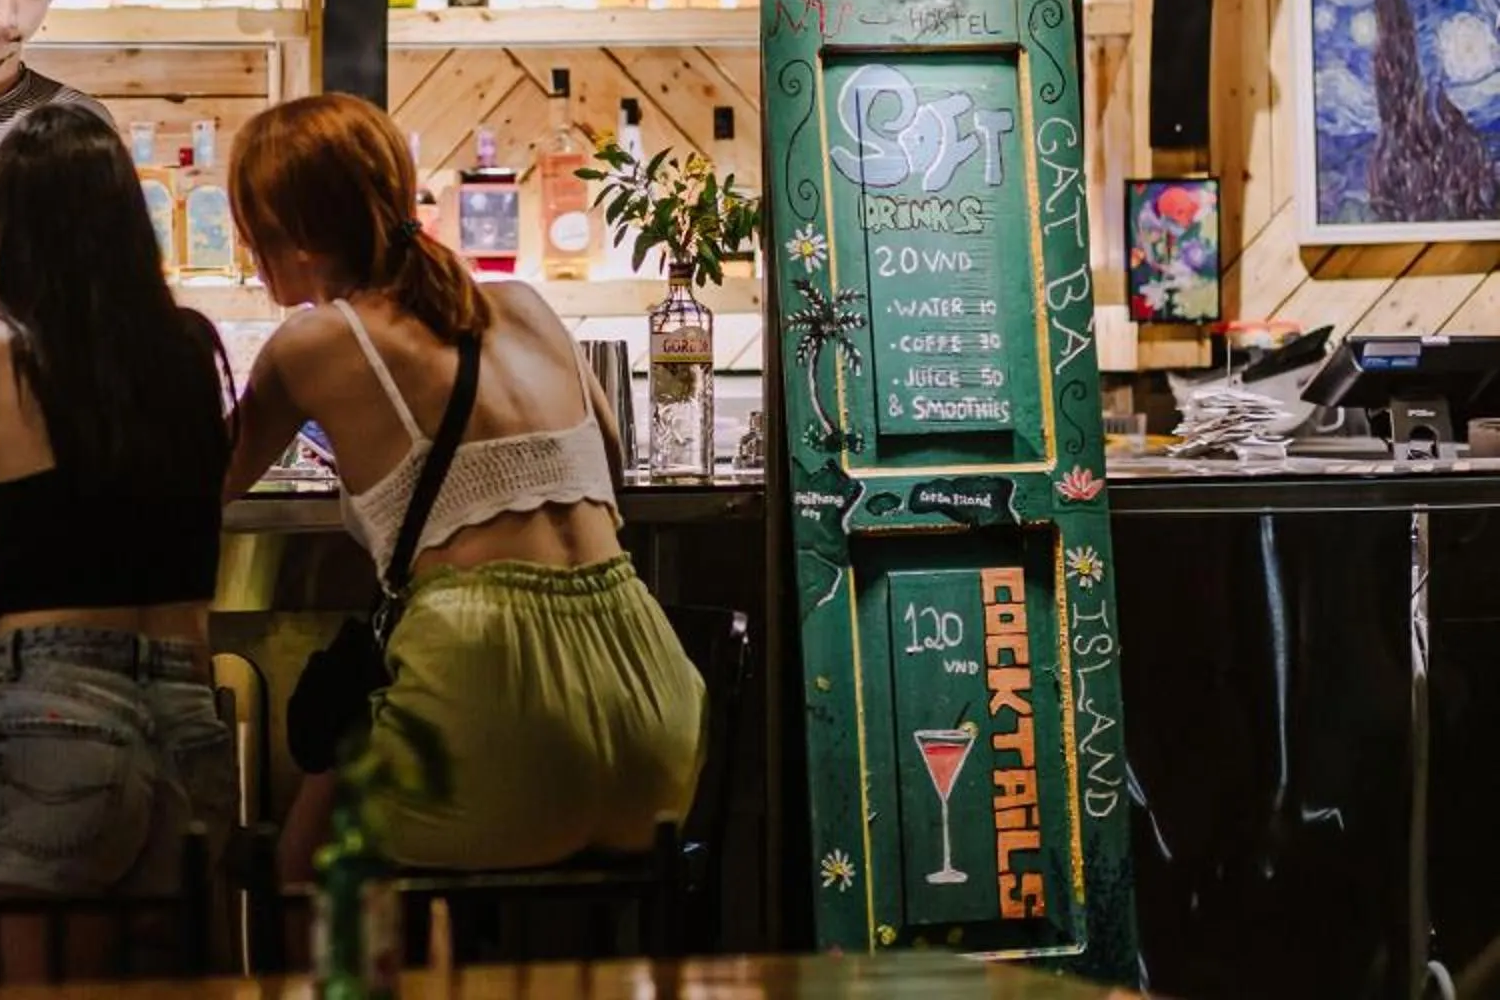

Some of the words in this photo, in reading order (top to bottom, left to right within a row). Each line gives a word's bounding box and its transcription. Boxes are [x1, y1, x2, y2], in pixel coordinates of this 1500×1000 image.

[875, 245, 918, 277] 20
[922, 249, 972, 273] VND
[893, 297, 964, 317] WATER
[903, 601, 963, 653] 120
[943, 658, 979, 676] VND
[979, 567, 1047, 919] COCKTAILS
